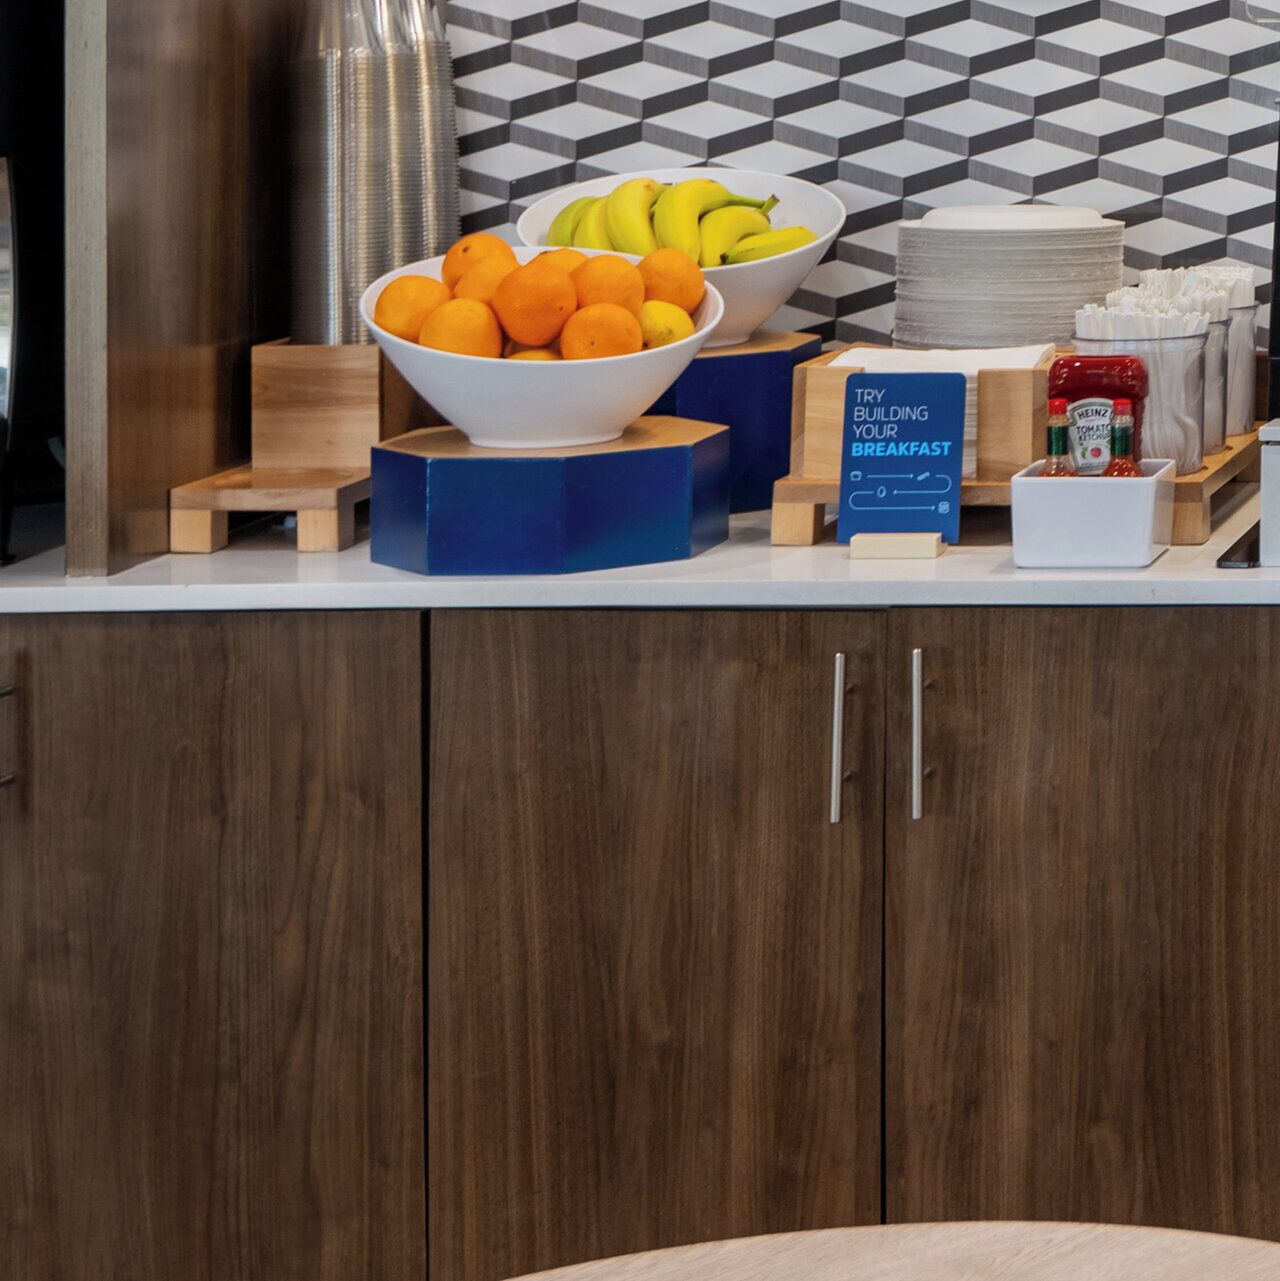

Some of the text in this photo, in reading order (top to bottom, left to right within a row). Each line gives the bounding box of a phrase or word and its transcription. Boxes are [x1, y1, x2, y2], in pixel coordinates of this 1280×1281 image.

[855, 388, 886, 404] TRY
[853, 405, 929, 422] BUILDING
[1077, 408, 1109, 420] HEINZ
[853, 423, 898, 439] YOUR
[851, 441, 952, 457] BREAKFAST
